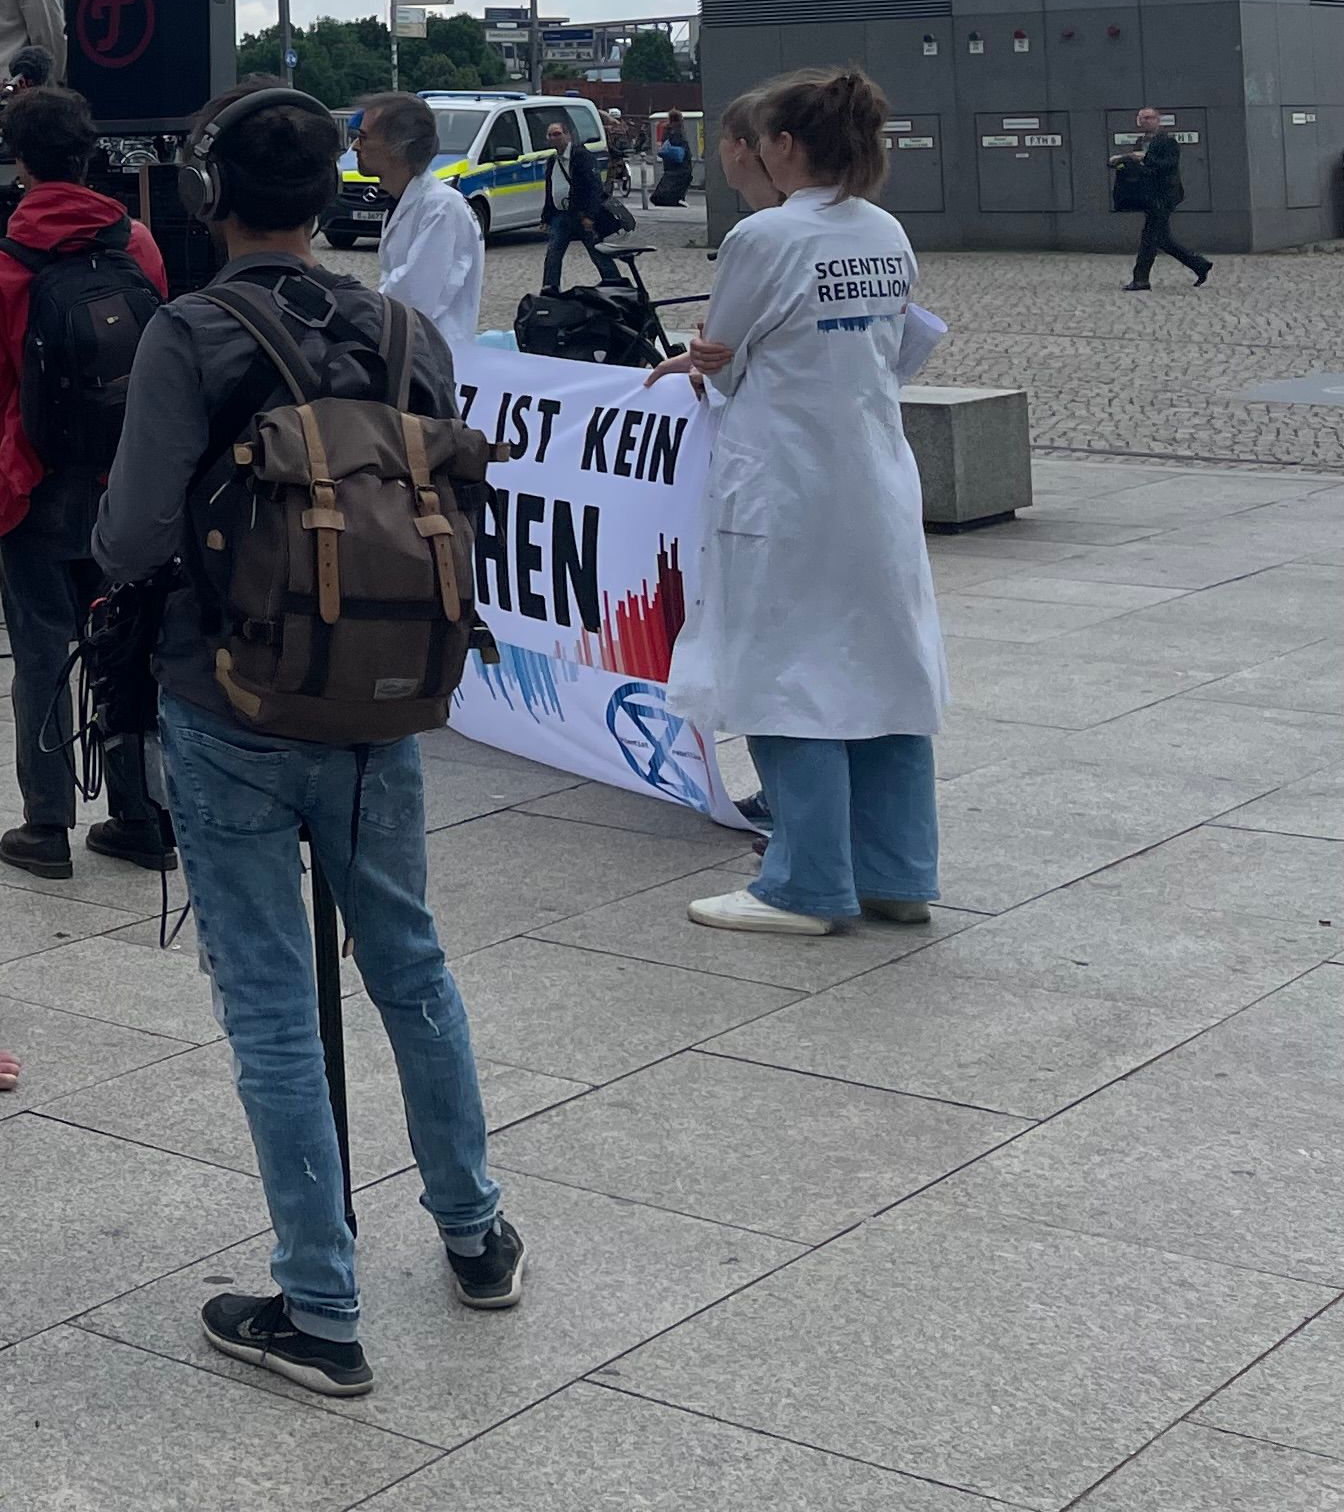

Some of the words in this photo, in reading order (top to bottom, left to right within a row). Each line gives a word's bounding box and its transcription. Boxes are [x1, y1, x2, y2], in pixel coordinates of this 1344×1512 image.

[815, 257, 902, 280] SCIENTIST
[817, 279, 910, 302] REBELLION
[495, 392, 561, 463] IST
[581, 407, 688, 485] KEIN
[474, 488, 601, 633] HEN
